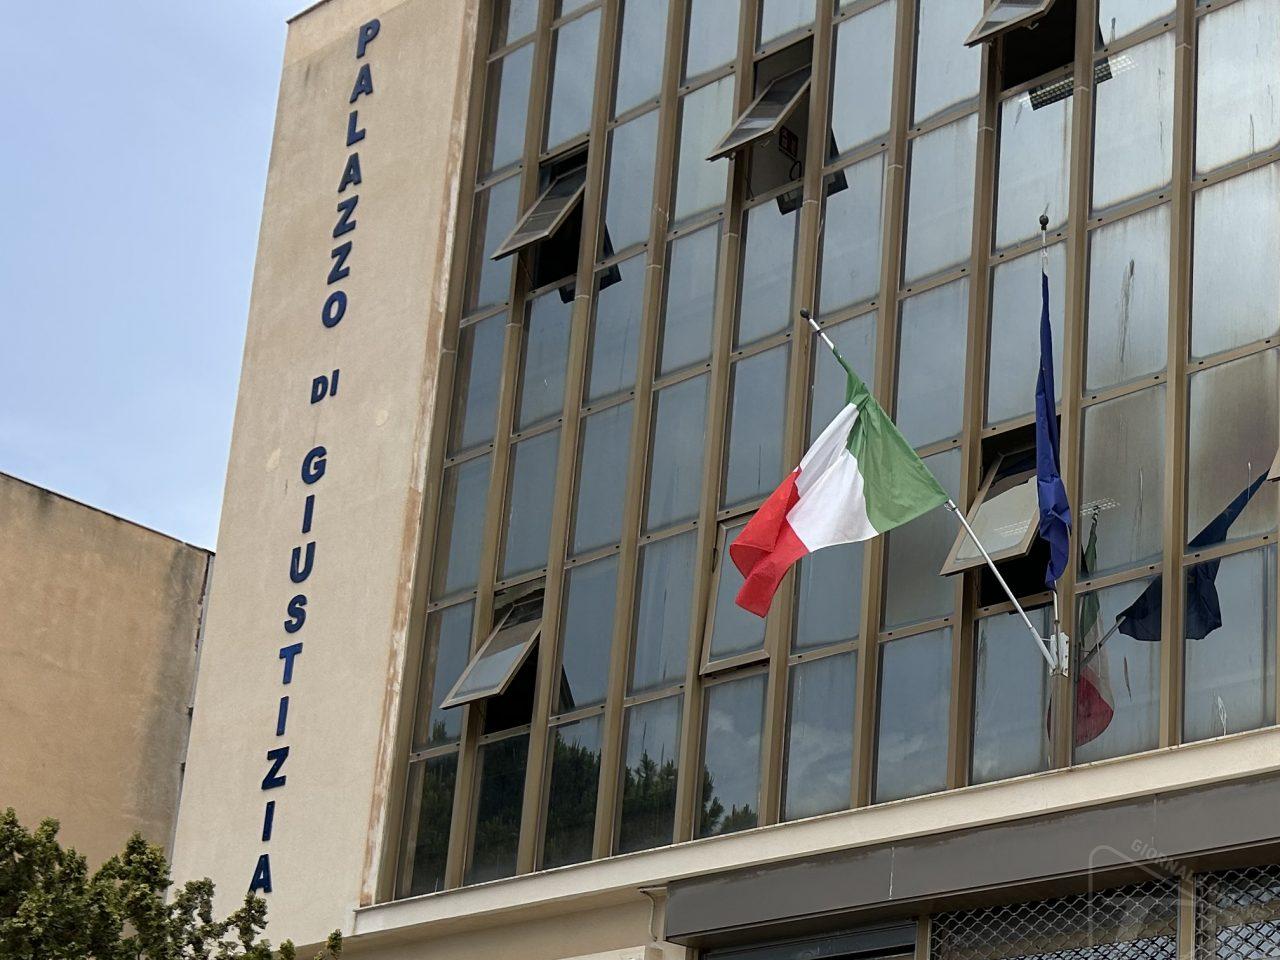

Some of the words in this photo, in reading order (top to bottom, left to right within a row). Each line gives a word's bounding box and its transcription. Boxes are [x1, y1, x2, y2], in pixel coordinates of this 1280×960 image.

[322, 18, 381, 328] PALAZZO
[311, 369, 340, 404] DI
[247, 445, 326, 894] GIUSTIZIA
